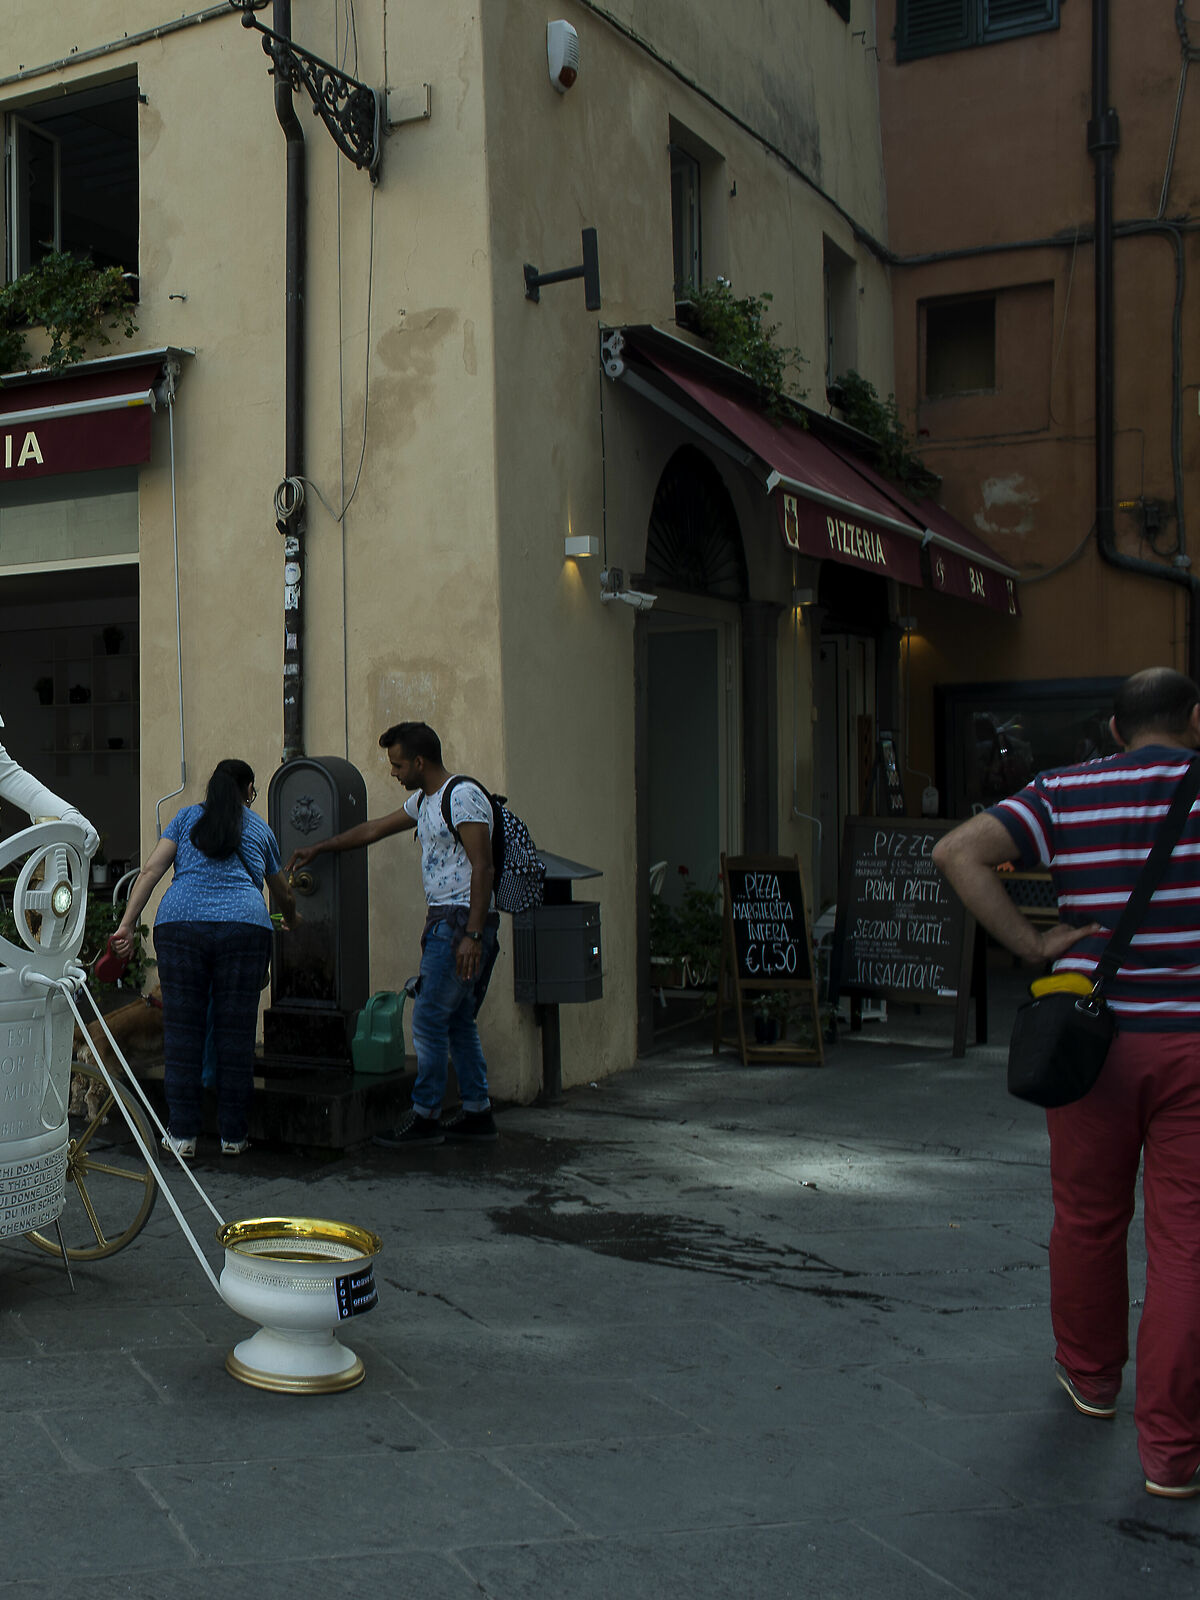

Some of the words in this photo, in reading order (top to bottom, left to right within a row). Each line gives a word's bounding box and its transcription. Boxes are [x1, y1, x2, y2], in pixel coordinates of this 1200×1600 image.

[826, 515, 886, 566] PIZZERIA
[969, 567, 985, 598] BAR
[732, 898, 794, 920] MARGHERITA
[8, 1027, 32, 1048] EST
[8, 1177, 32, 1191] THAT
[4, 1208, 18, 1220] DU
[20, 1203, 36, 1217] MIR
[38, 1210, 50, 1223] ICH
[339, 1279, 349, 1316] FOTO
